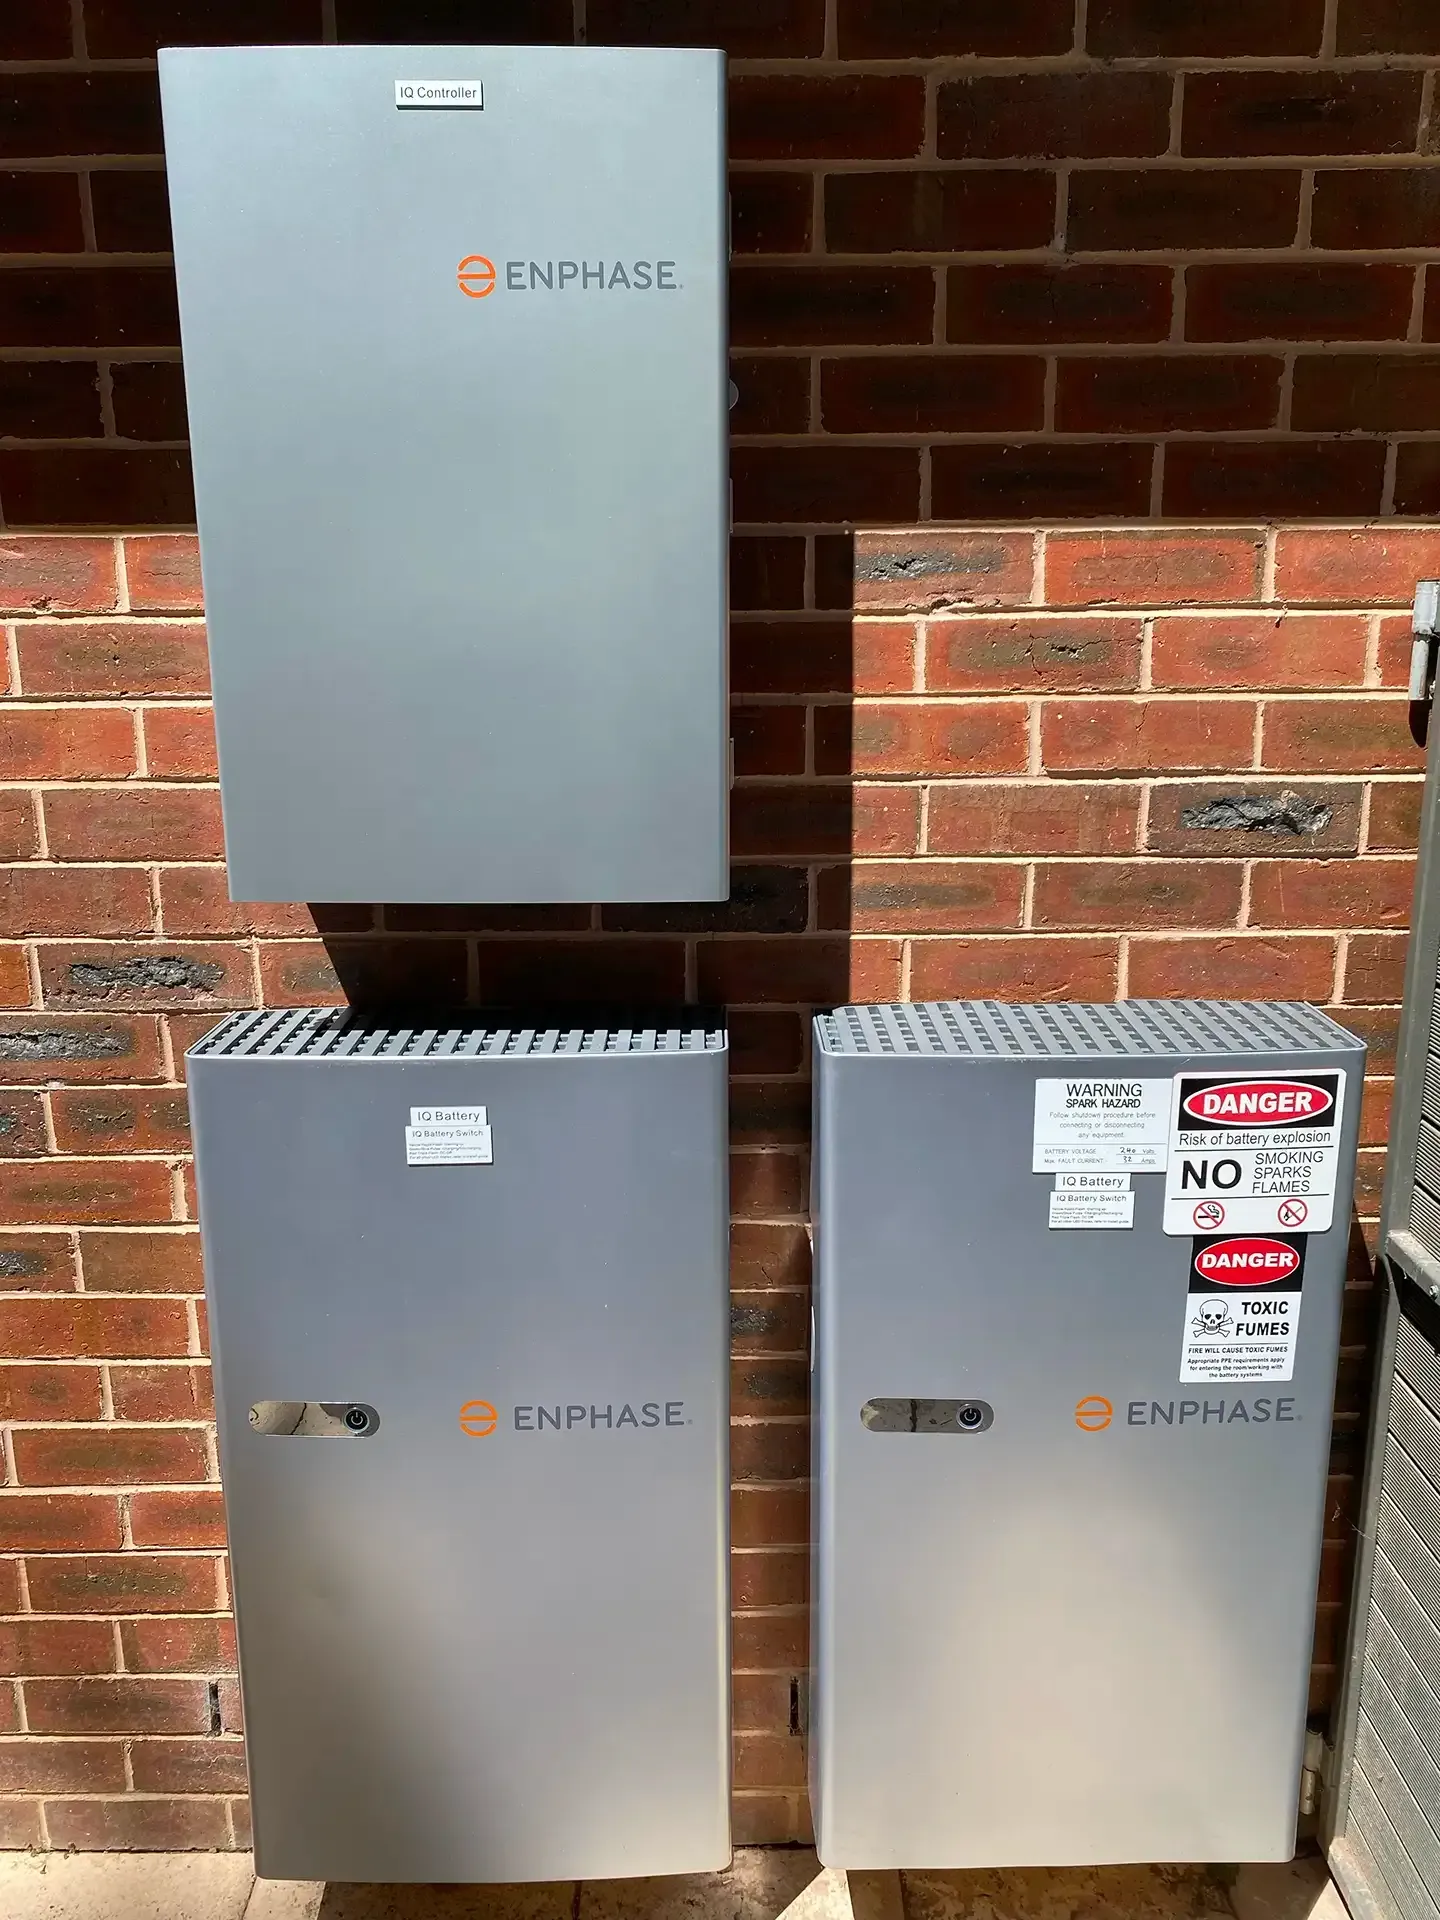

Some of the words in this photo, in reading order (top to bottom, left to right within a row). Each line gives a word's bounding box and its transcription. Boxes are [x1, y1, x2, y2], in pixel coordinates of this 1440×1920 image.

[400, 86, 414, 99] IQ
[417, 86, 477, 99] Controller
[506, 260, 677, 290] ENPHASE
[1066, 1083, 1142, 1097] WARNING
[1065, 1098, 1098, 1108] SPARK
[1101, 1098, 1141, 1108] HAZARD
[1203, 1091, 1313, 1115] DANGER
[417, 1111, 432, 1122] IQ
[435, 1111, 480, 1122] Battery
[1103, 1112, 1134, 1120] procedure
[412, 1130, 422, 1138] IQ
[424, 1130, 454, 1139] Battery
[456, 1129, 484, 1137] Switch
[1179, 1133, 1207, 1146] Risk
[1210, 1133, 1223, 1145] of
[1226, 1133, 1269, 1147] battery
[1273, 1131, 1331, 1146] explosion
[1255, 1151, 1324, 1164] SMOKING
[1181, 1159, 1242, 1190] NO
[1253, 1166, 1312, 1179] SPARKS
[1062, 1176, 1076, 1187] IQ
[1079, 1176, 1124, 1188] Battery
[1252, 1180, 1310, 1194] FLAMES
[1056, 1194, 1066, 1202] IQ
[1067, 1194, 1097, 1203] Battery
[1099, 1194, 1127, 1202] Switch
[1201, 1252, 1294, 1269] DANGER
[1241, 1301, 1289, 1315] TOXIC
[1235, 1322, 1290, 1337] FUMES
[514, 1401, 685, 1431] ENPHASE
[1127, 1398, 1296, 1426] ENPHASE
